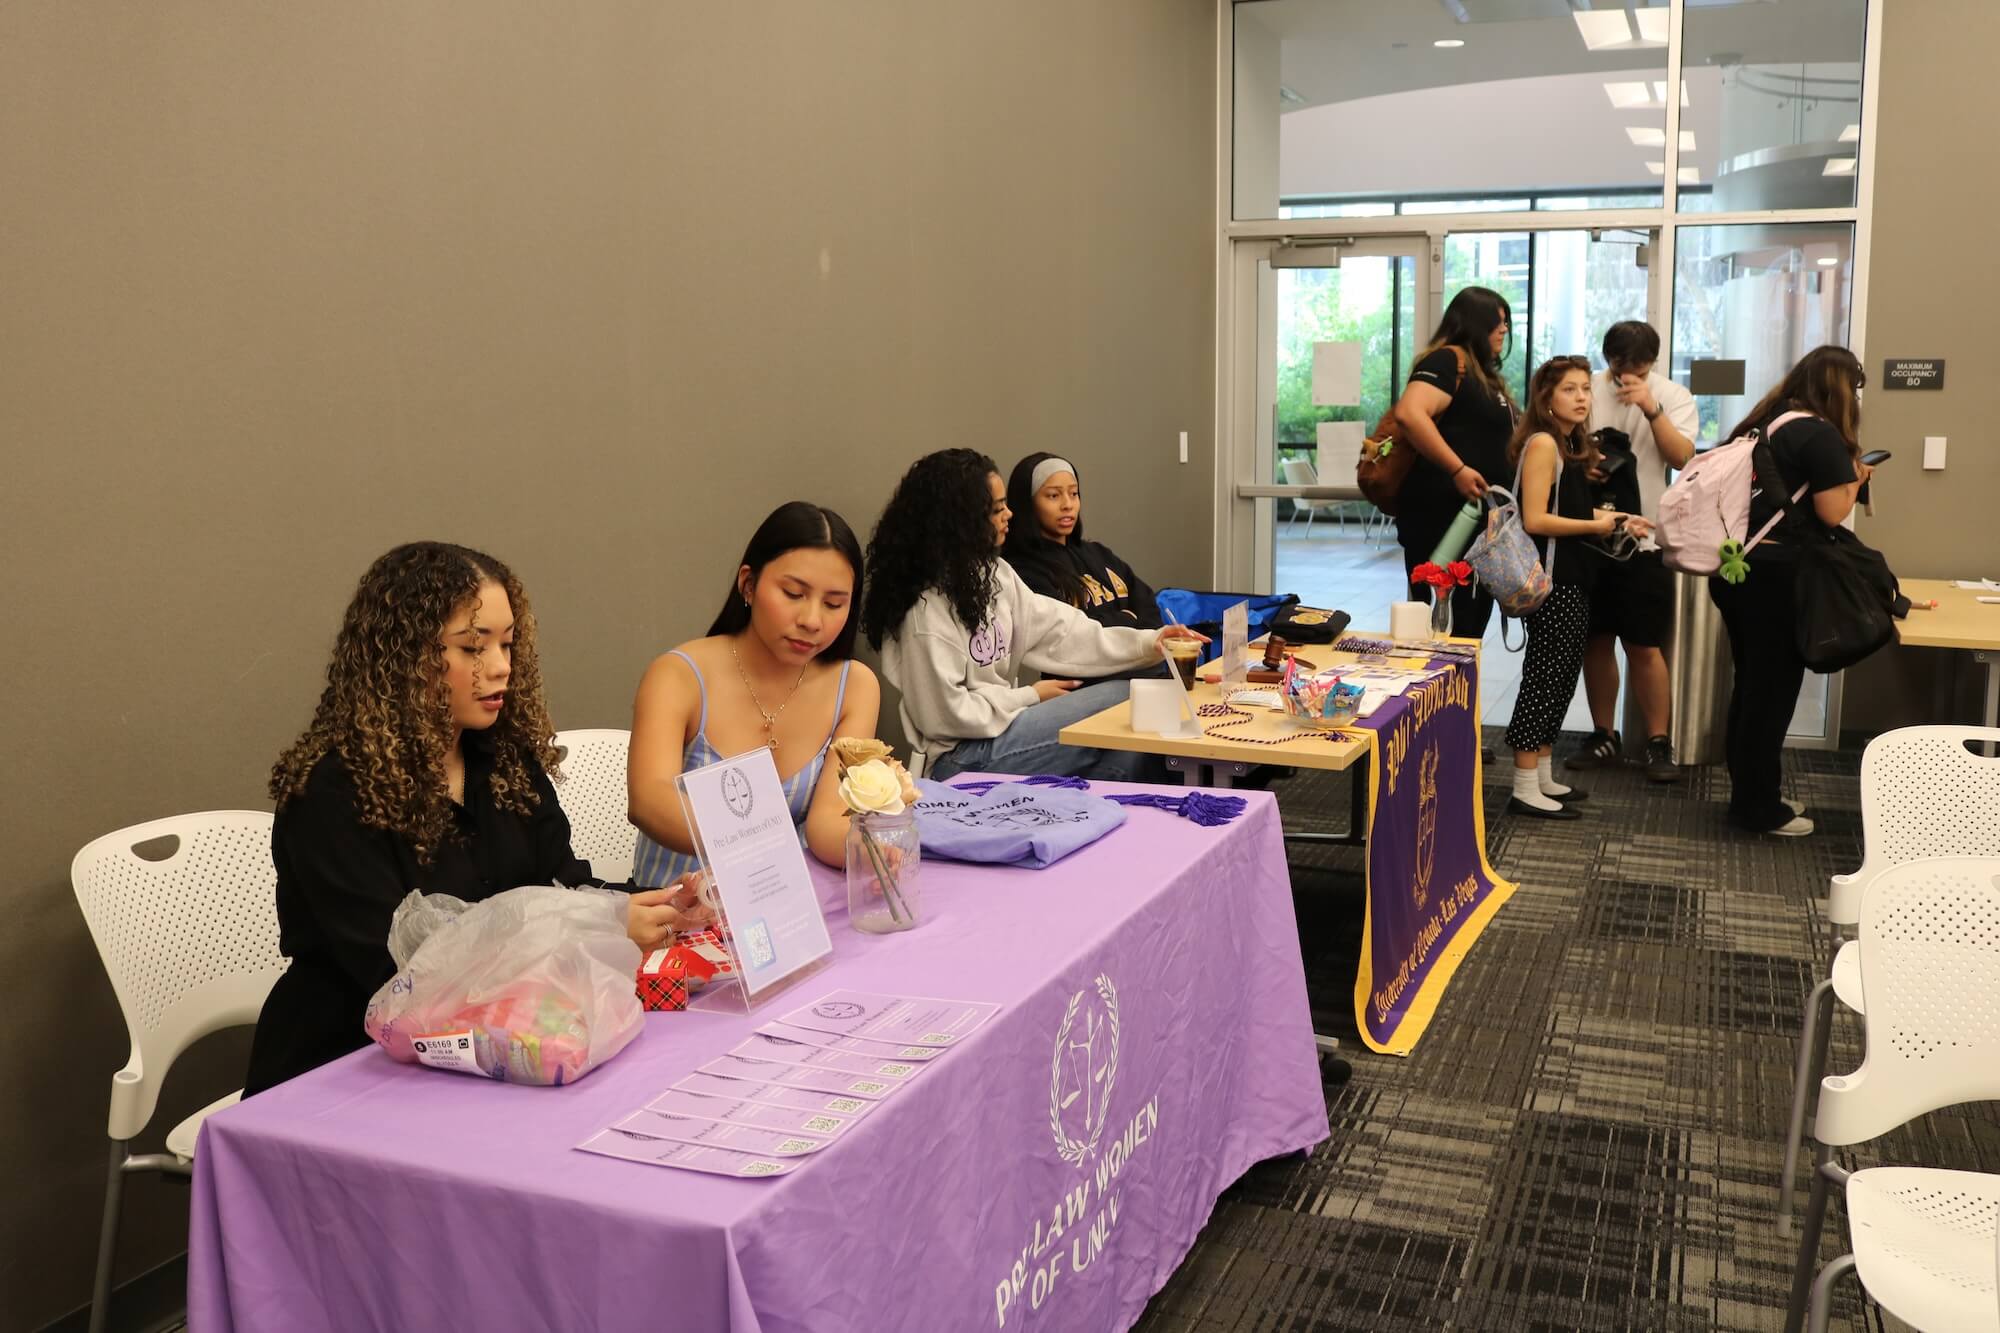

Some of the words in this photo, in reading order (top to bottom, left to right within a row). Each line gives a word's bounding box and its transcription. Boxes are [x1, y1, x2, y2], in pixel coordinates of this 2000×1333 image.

[1896, 362, 1933, 370] MAXIMUM
[1906, 377, 1921, 386] 80
[1096, 1095, 1158, 1201] WOMEN
[1031, 1250, 1065, 1311] OF
[1072, 1187, 1121, 1273] UNLV
